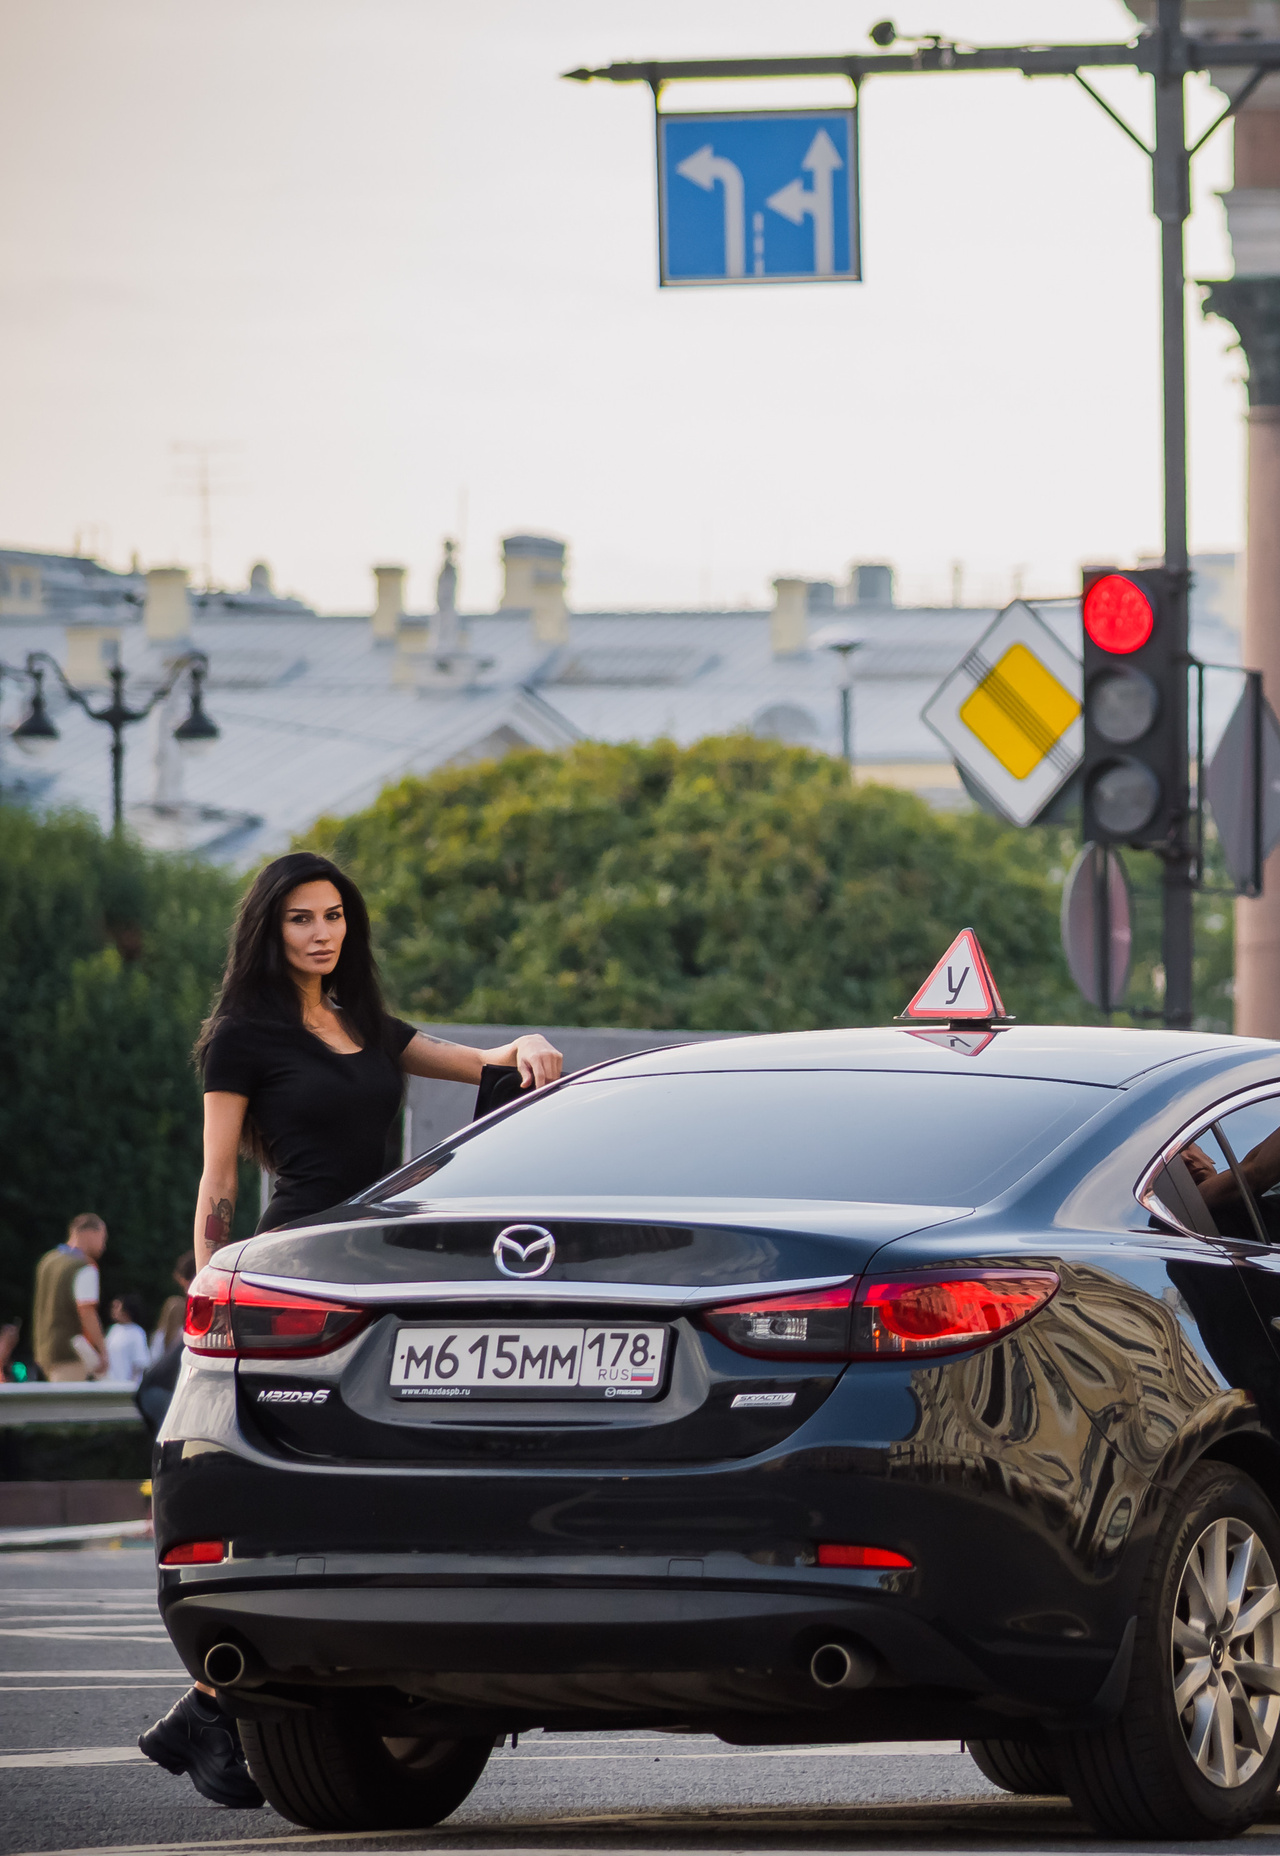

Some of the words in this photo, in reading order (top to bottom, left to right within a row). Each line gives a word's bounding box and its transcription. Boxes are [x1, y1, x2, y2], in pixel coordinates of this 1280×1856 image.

[945, 966, 970, 1005] У
[587, 1333, 650, 1367] 178
[598, 1369, 629, 1381] RUS
[401, 1387, 471, 1397] www.mazdaspb.ru
